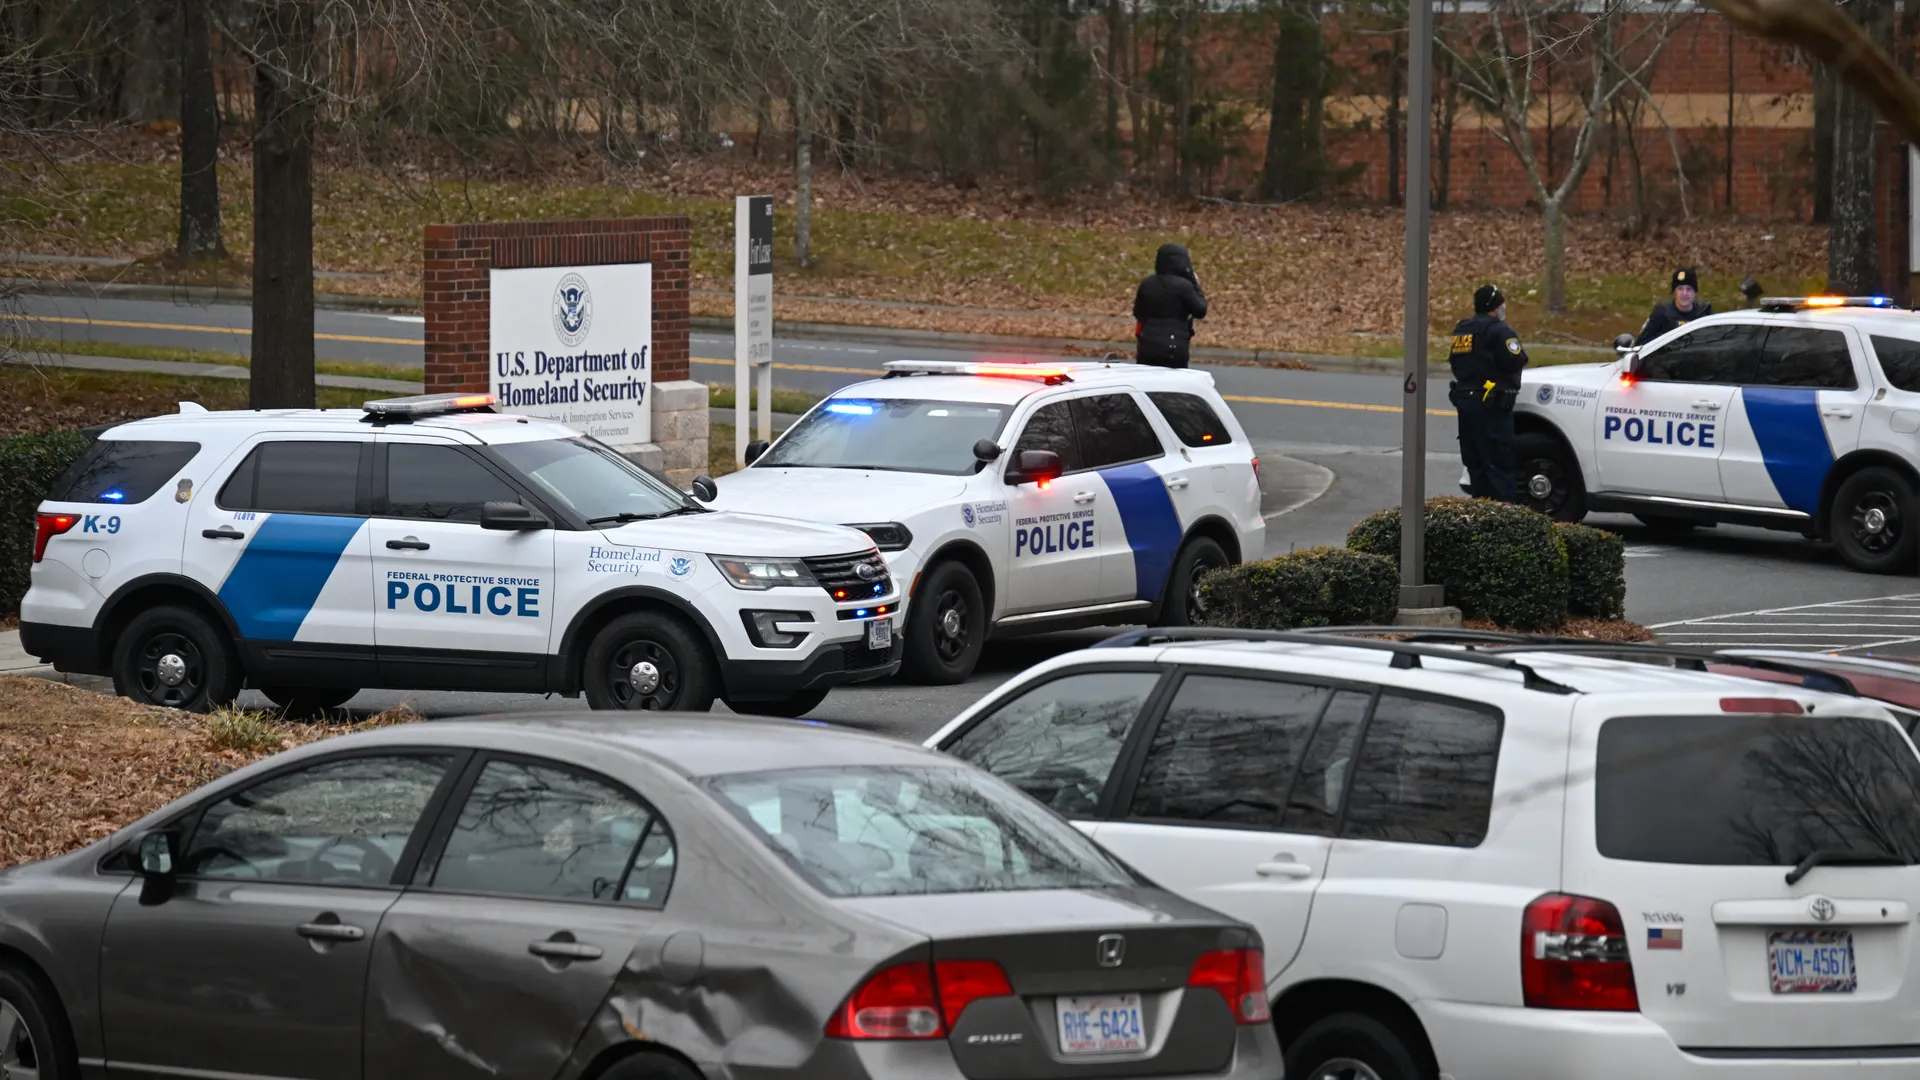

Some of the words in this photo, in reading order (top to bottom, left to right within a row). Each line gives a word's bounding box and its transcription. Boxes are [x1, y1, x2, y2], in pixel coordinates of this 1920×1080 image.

[497, 351, 530, 377] U.S.
[534, 348, 627, 381] Department
[631, 345, 648, 370] of
[498, 378, 579, 408] Homeland
[583, 376, 646, 406] Security
[1404, 372, 1417, 394] 6
[1556, 386, 1598, 399] Homeland
[1555, 396, 1588, 410] Security
[561, 412, 568, 424] &
[569, 411, 607, 425] Immigration
[608, 409, 634, 421] Services
[1605, 406, 1637, 415] FEDERAL
[1639, 409, 1684, 420] PROTECTIVE
[1686, 413, 1716, 422] SERVICE
[590, 426, 629, 438] Enforcement
[1604, 416, 1716, 448] POLICE
[975, 500, 1007, 514] Homeland
[83, 514, 121, 534] K-9
[977, 512, 1002, 526] Security
[1015, 516, 1038, 527] FEDERAL
[1039, 512, 1071, 523] PROTECTIVE
[1072, 509, 1094, 519] SERVICE
[1015, 520, 1094, 558] POLICE
[589, 546, 661, 563] Homeland
[587, 559, 644, 577] Security
[387, 571, 430, 582] FEDERAL
[433, 573, 495, 585] PROTECTIVE
[497, 577, 540, 587] SERVICE
[387, 580, 540, 618] POLICE
[1775, 947, 1847, 976] VCM-4567
[1063, 1008, 1140, 1040] RHE-6424
